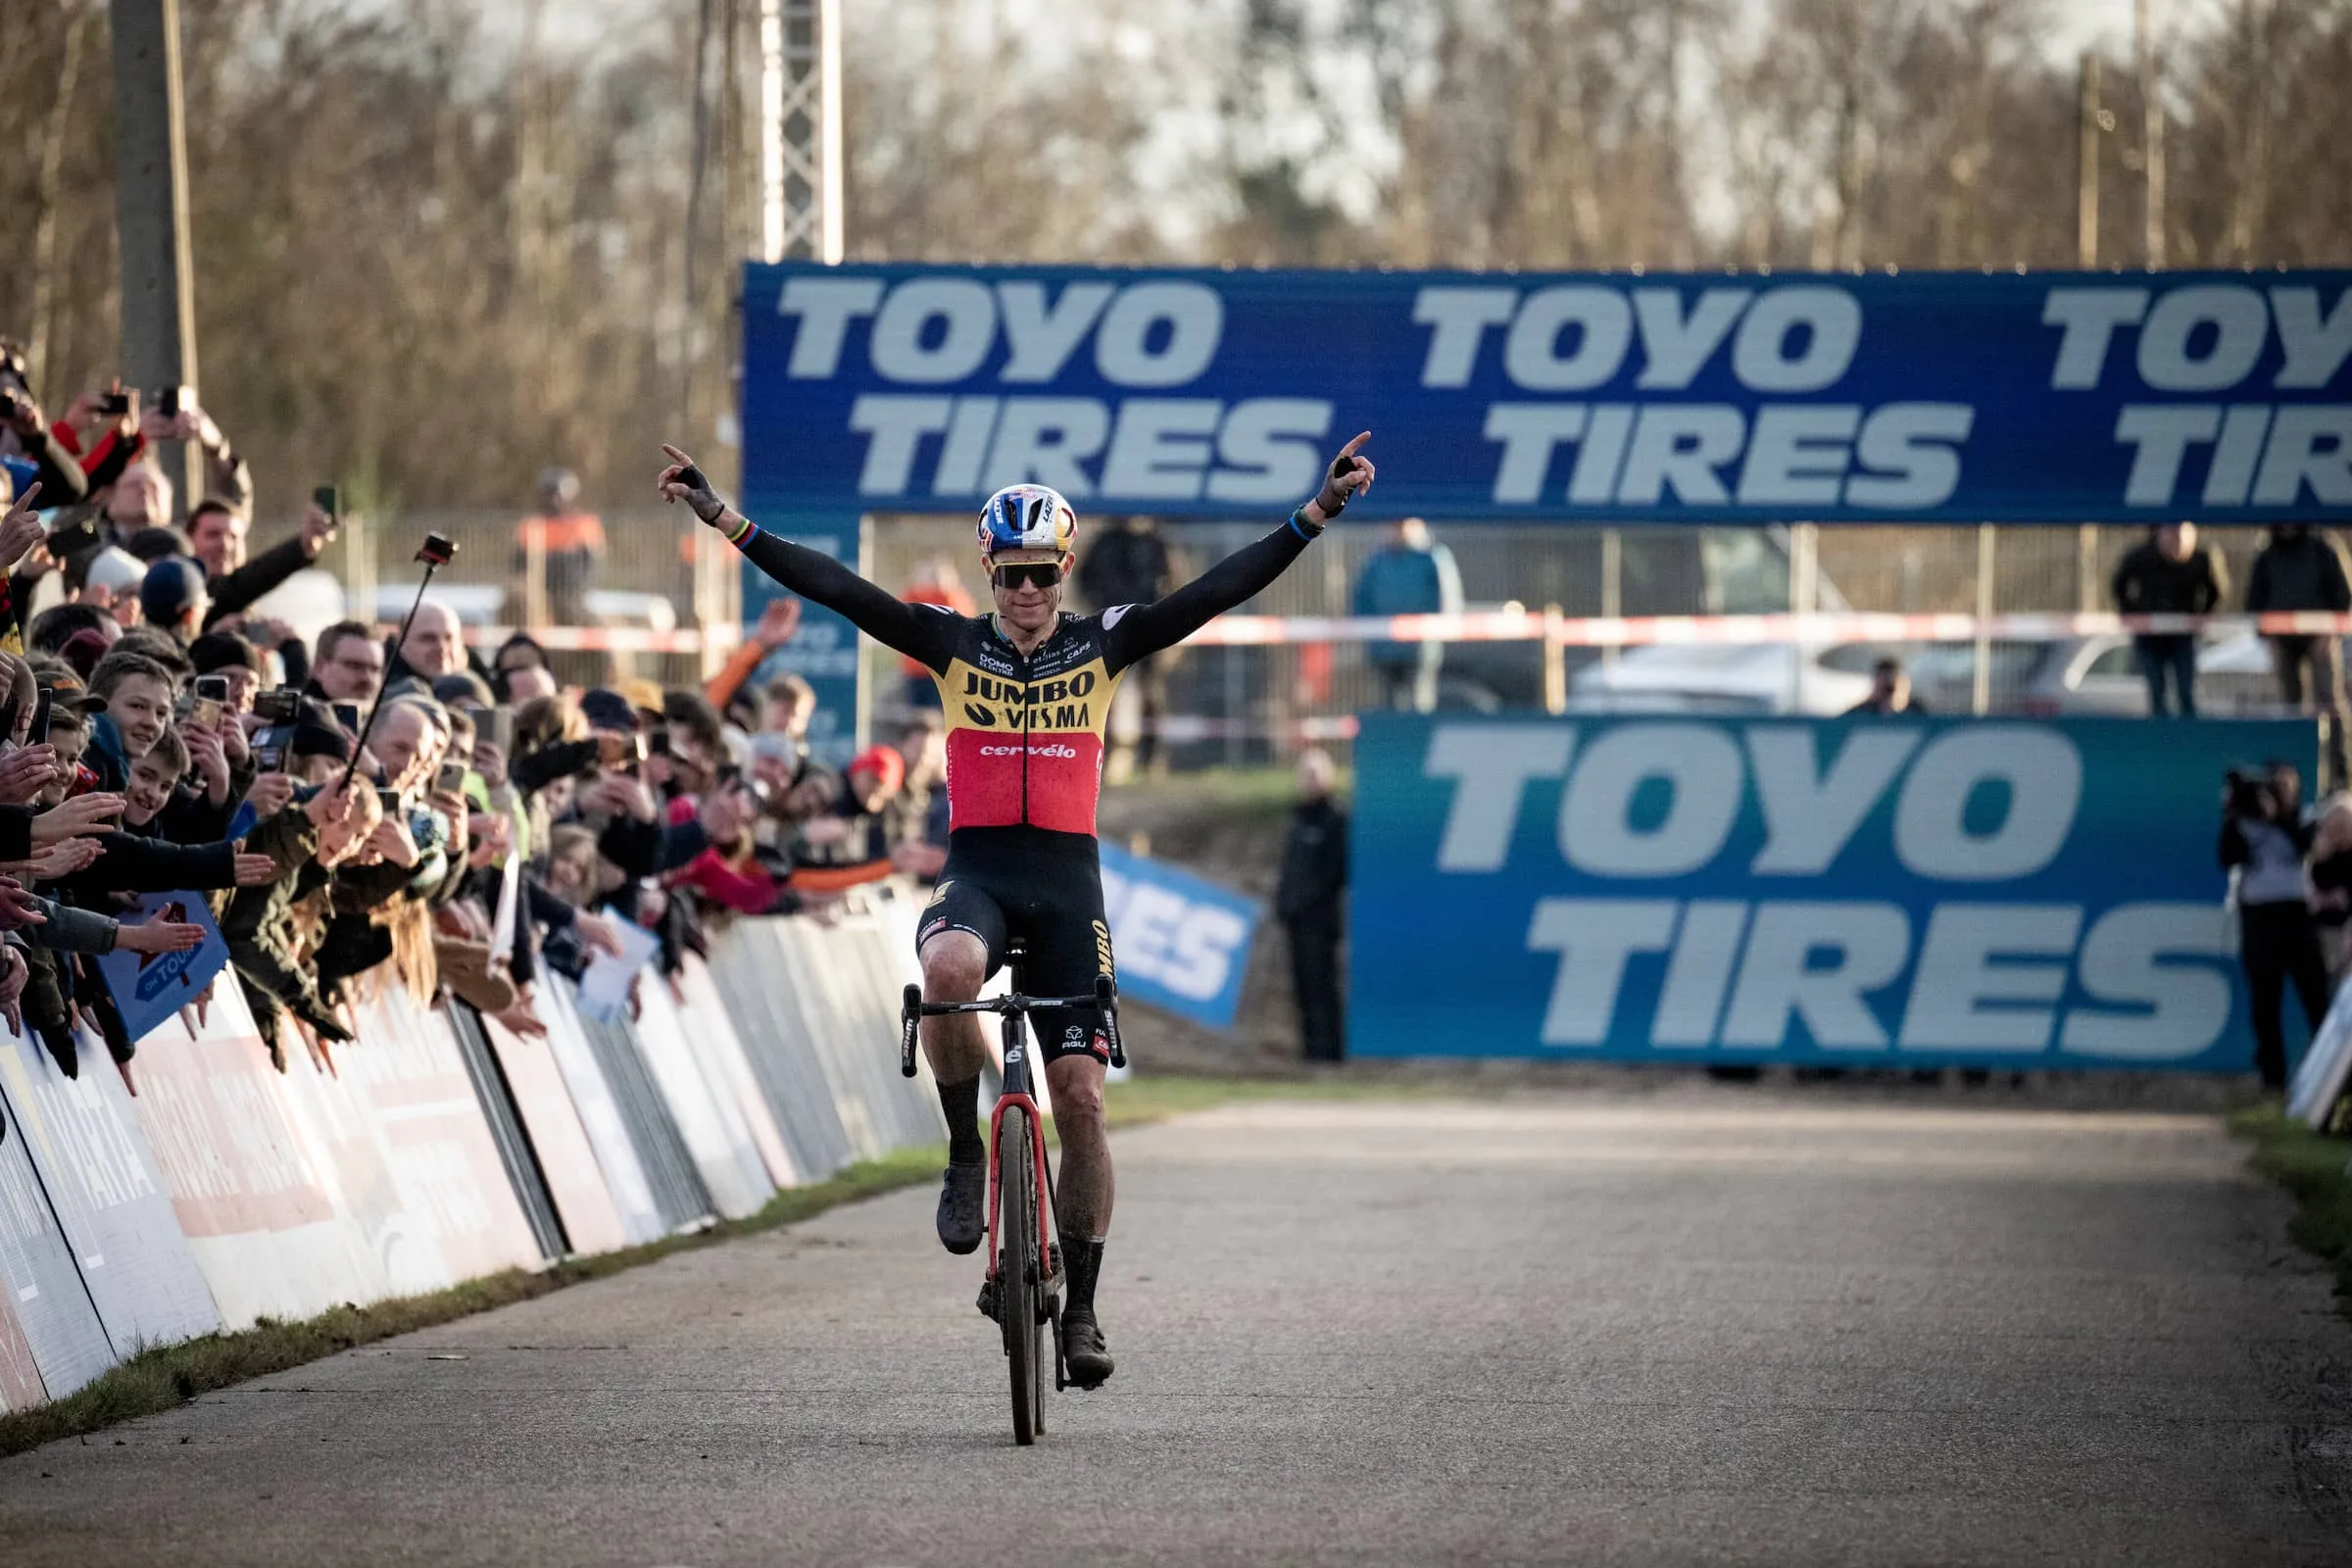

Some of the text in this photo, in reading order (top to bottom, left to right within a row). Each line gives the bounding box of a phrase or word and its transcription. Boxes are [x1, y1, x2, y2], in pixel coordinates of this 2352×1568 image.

[778, 278, 1225, 385] TOYO
[1412, 284, 1863, 392] TOYO
[2040, 283, 2352, 391] TOY
[849, 394, 1335, 502] TIRES
[1484, 402, 1976, 509] TIRES
[2114, 404, 2352, 507] TIR
[964, 670, 1096, 706] JUMBO
[979, 653, 1014, 671] DOMO
[1066, 640, 1092, 661] CAPS
[980, 744, 1077, 759] cervélo
[1005, 703, 1090, 729] VISMA
[1422, 721, 2082, 882] TOYO
[1092, 919, 1113, 978] MBO
[1102, 864, 1245, 1003] ES
[1526, 896, 2232, 1060] TIRES
[902, 1018, 914, 1058] SRAM
[1061, 1041, 1087, 1050] AGU
